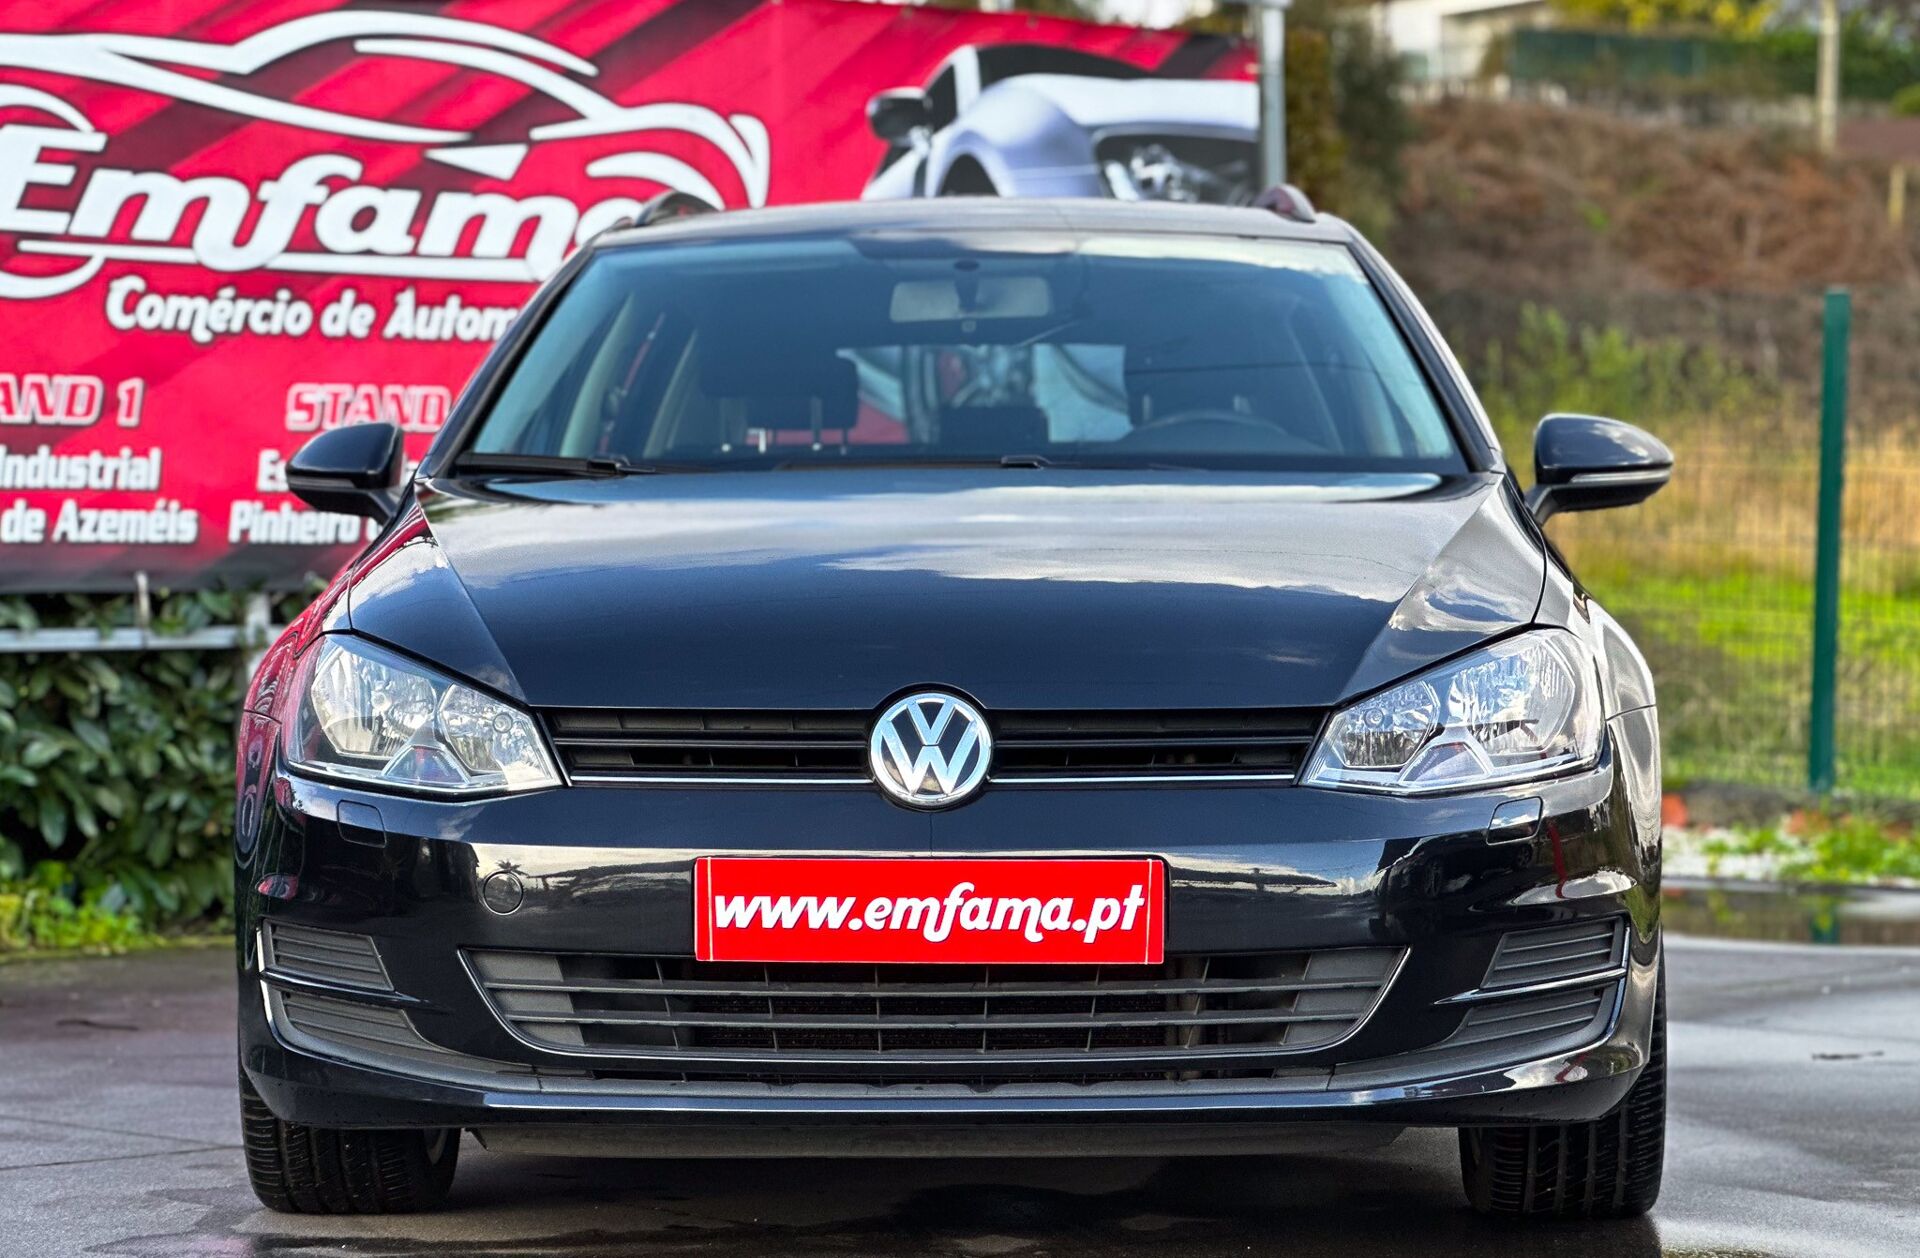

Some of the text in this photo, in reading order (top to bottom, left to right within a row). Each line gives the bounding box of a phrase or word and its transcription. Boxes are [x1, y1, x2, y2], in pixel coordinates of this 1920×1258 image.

[106, 274, 313, 343] Comércio
[320, 288, 376, 338] de
[117, 377, 144, 427] 1
[285, 383, 452, 433] STAND
[0, 498, 198, 543] de Azeméis
[227, 500, 360, 544] Pinheiro
[714, 882, 1145, 944] www.emfama.pt
